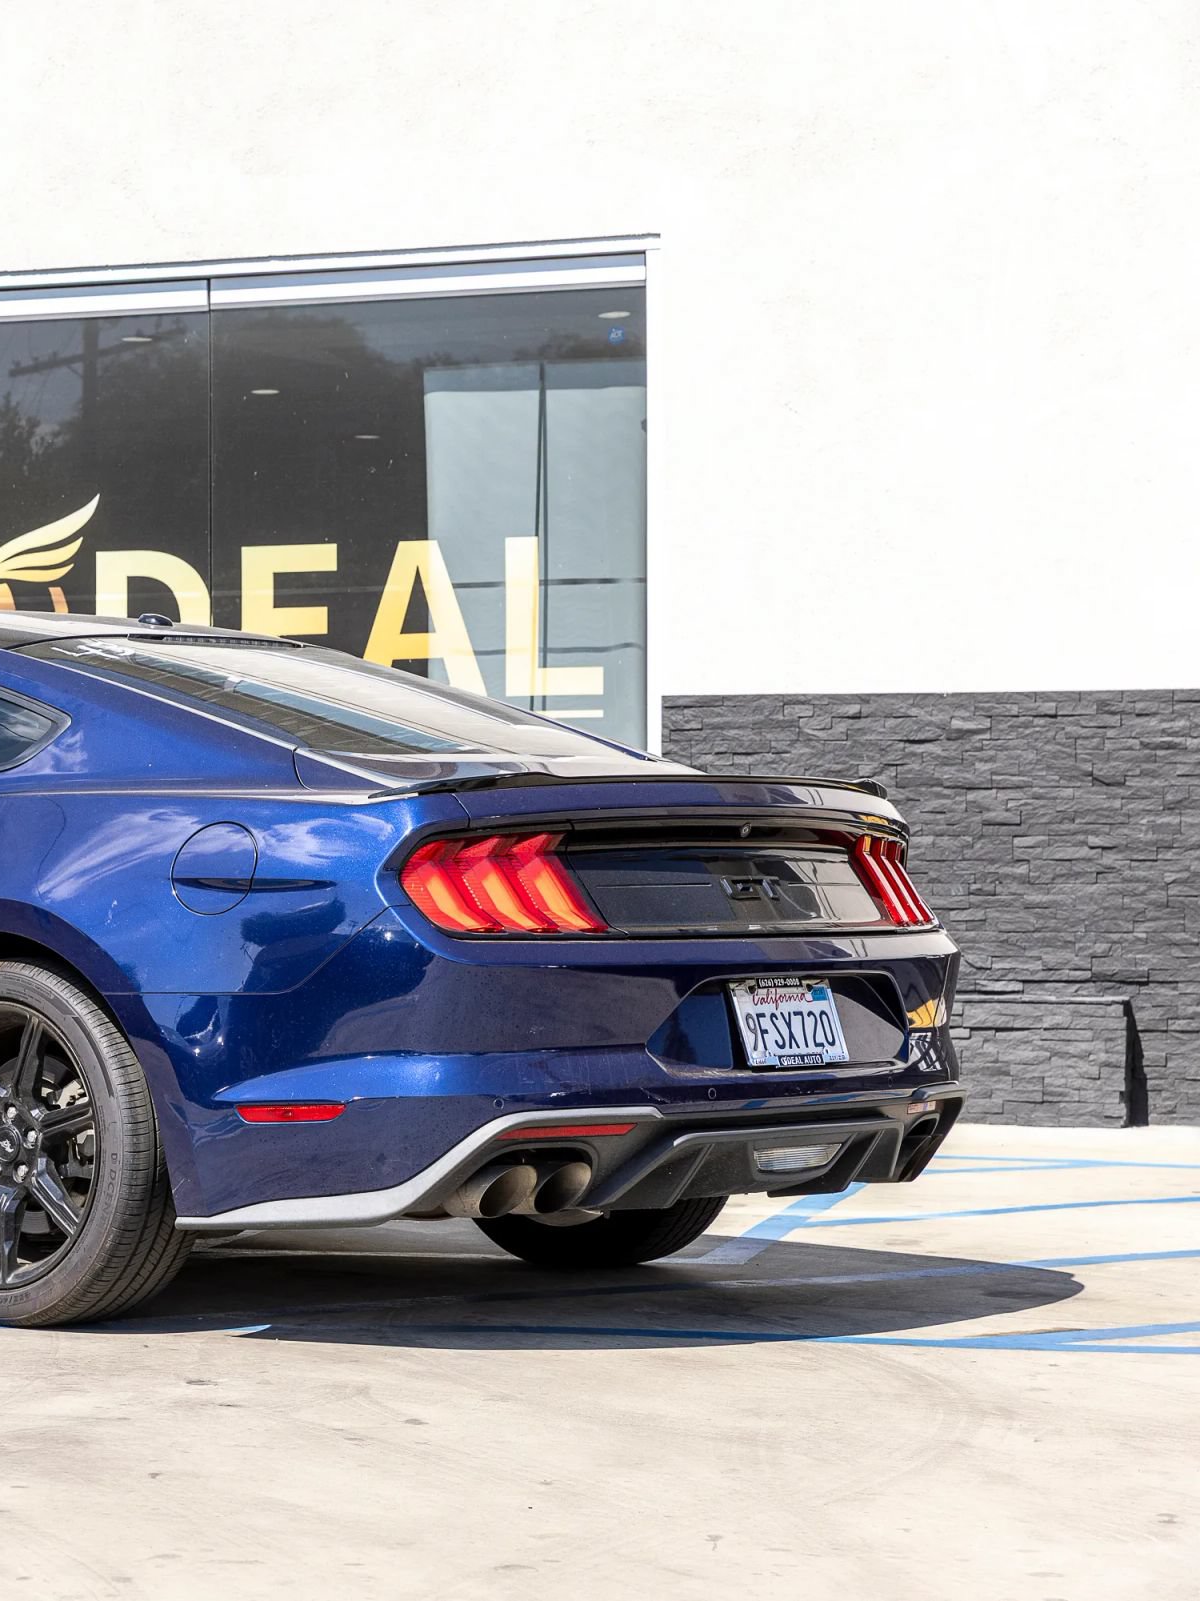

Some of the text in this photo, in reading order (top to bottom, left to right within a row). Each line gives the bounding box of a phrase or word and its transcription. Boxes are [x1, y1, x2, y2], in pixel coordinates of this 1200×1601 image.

[720, 875, 781, 901] GT
[752, 987, 814, 1011] California
[745, 1009, 836, 1052] 9FSX720
[803, 1054, 822, 1065] AUTO
